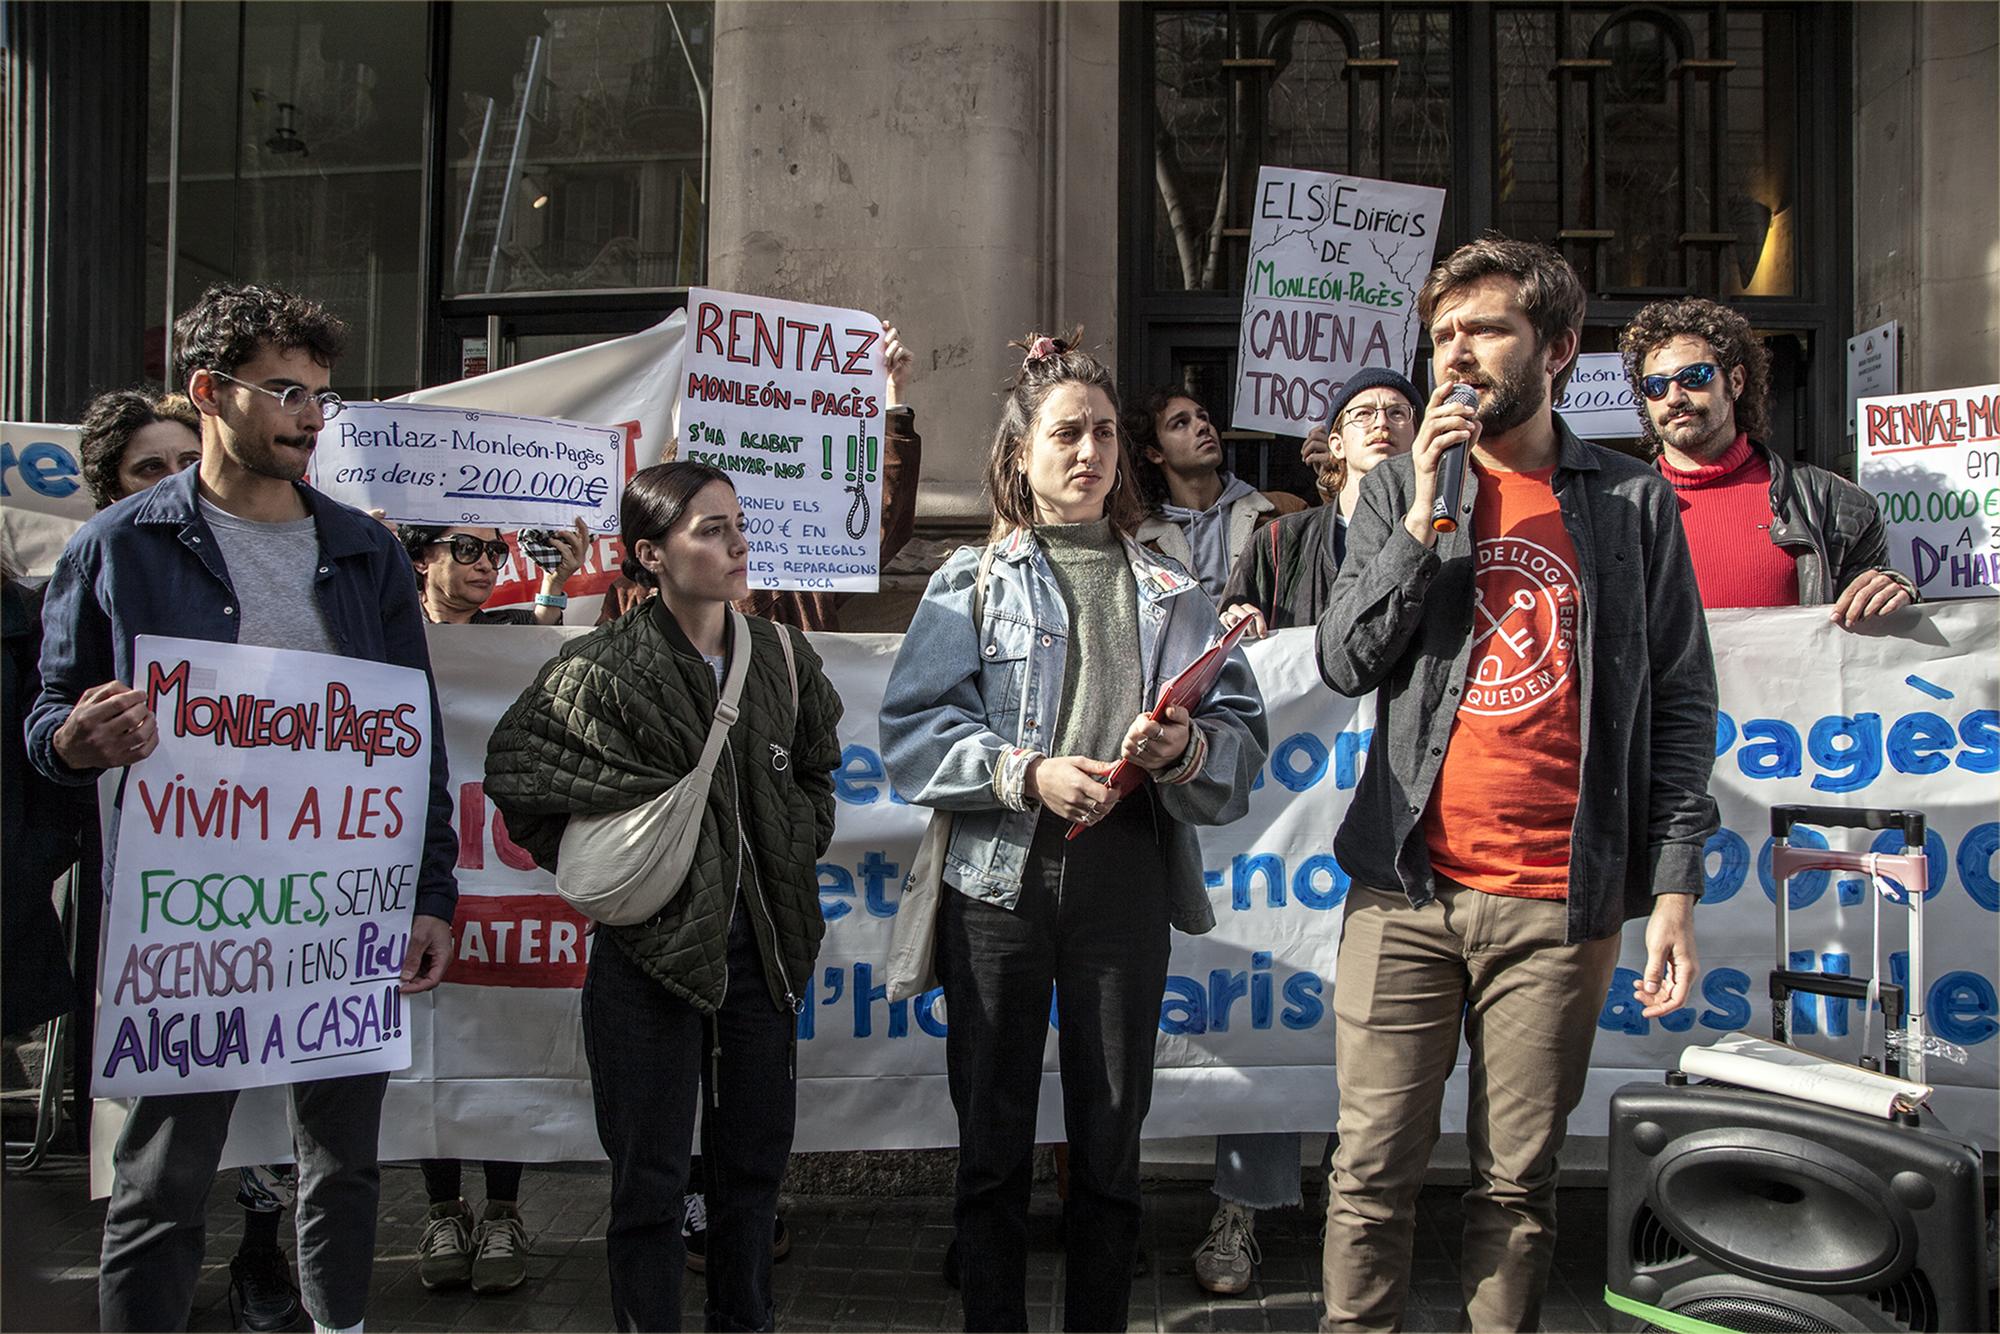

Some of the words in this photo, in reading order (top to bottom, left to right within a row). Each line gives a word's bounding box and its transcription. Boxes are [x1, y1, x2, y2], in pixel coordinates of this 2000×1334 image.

[1262, 182, 1325, 222] ELS
[1320, 239, 1352, 265] DE
[696, 302, 880, 376] RENTAZ
[1251, 309, 1356, 364] CAUEN
[1360, 319, 1392, 369] A
[688, 421, 726, 447] S'HA
[740, 431, 804, 453] ACABAT
[336, 465, 376, 485] ens
[457, 464, 609, 505] 200.000€
[793, 500, 820, 513] ELS
[803, 524, 827, 538] EN
[1956, 526, 1974, 549] A
[749, 560, 775, 572] LES
[763, 576, 780, 587] US
[795, 577, 835, 589] TOCA
[1480, 547, 1504, 564] DE
[1510, 547, 1574, 650] LLOGATERES
[1466, 669, 1556, 706] QUEDEM
[288, 786, 322, 841] A
[337, 785, 404, 841] LES
[140, 869, 331, 934] FOSQUES,
[335, 864, 414, 917] SENSE
[450, 919, 595, 964] ATER
[114, 937, 275, 1006] ASCENSOR
[302, 937, 348, 985] ENS
[261, 1014, 285, 1065] A
